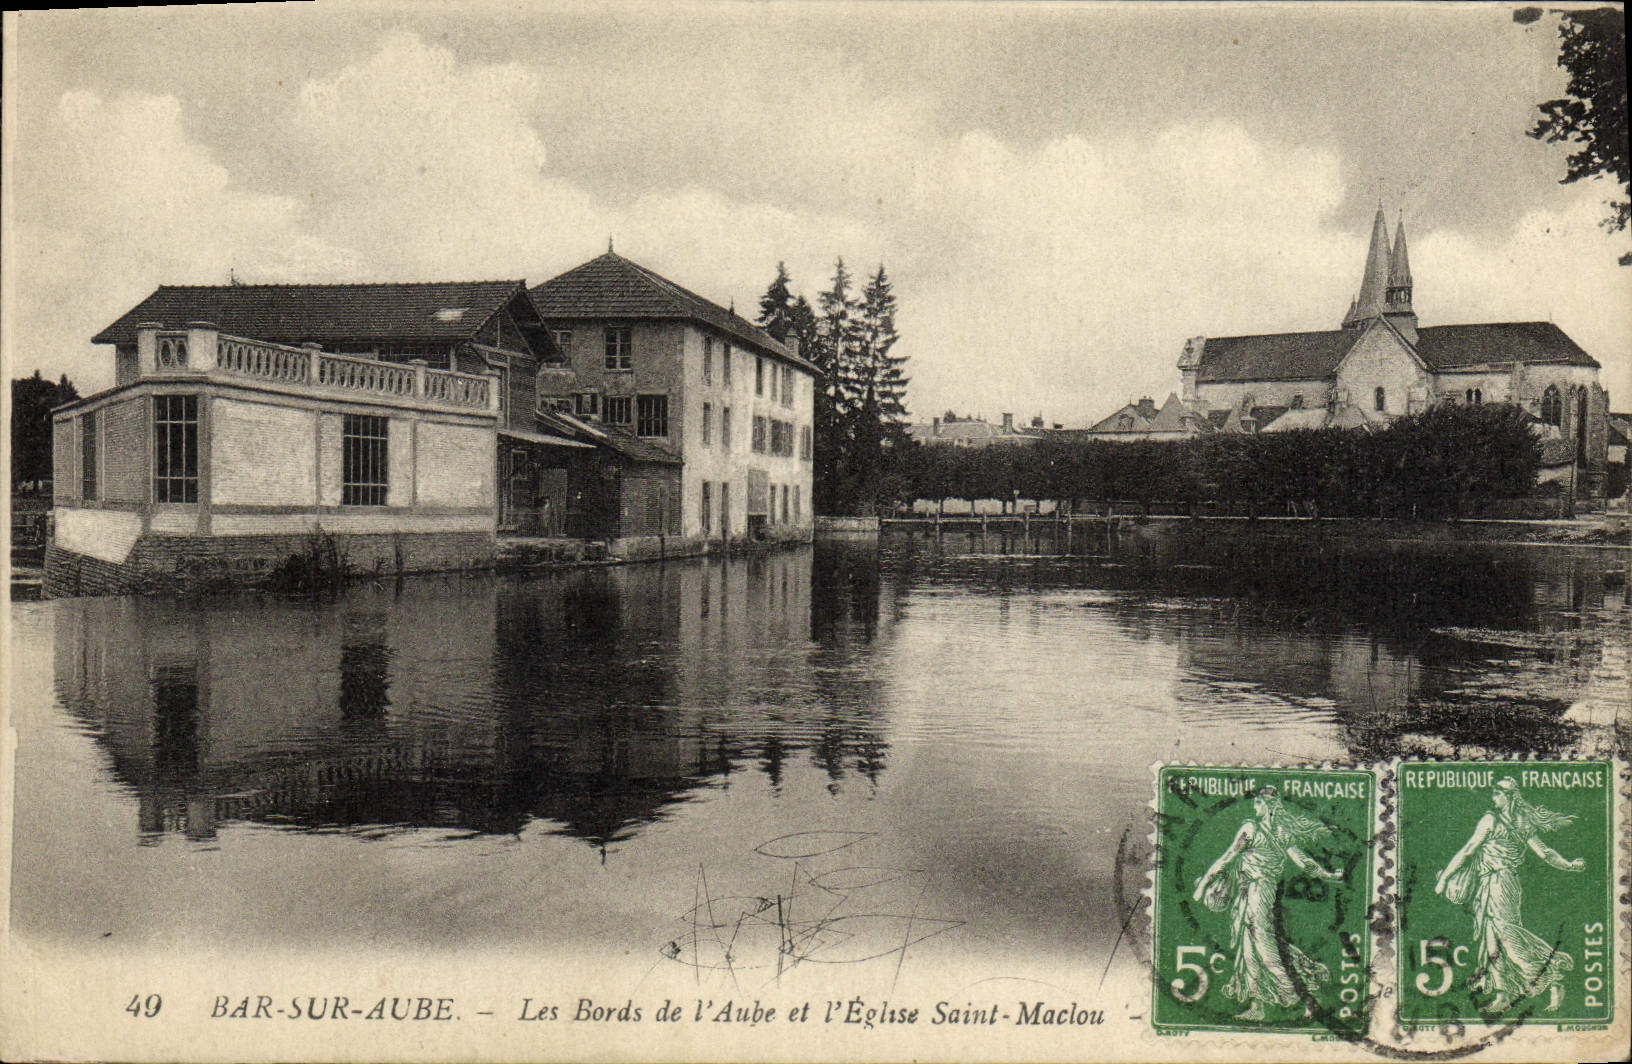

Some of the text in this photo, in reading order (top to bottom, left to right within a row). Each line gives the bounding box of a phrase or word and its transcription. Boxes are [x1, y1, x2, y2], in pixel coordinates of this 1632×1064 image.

[1283, 779, 1366, 801] FRANÇAISE
[1405, 770, 1604, 791] REPUBLIQUE FRANÇAISE
[1584, 921, 1603, 1007] POSTES
